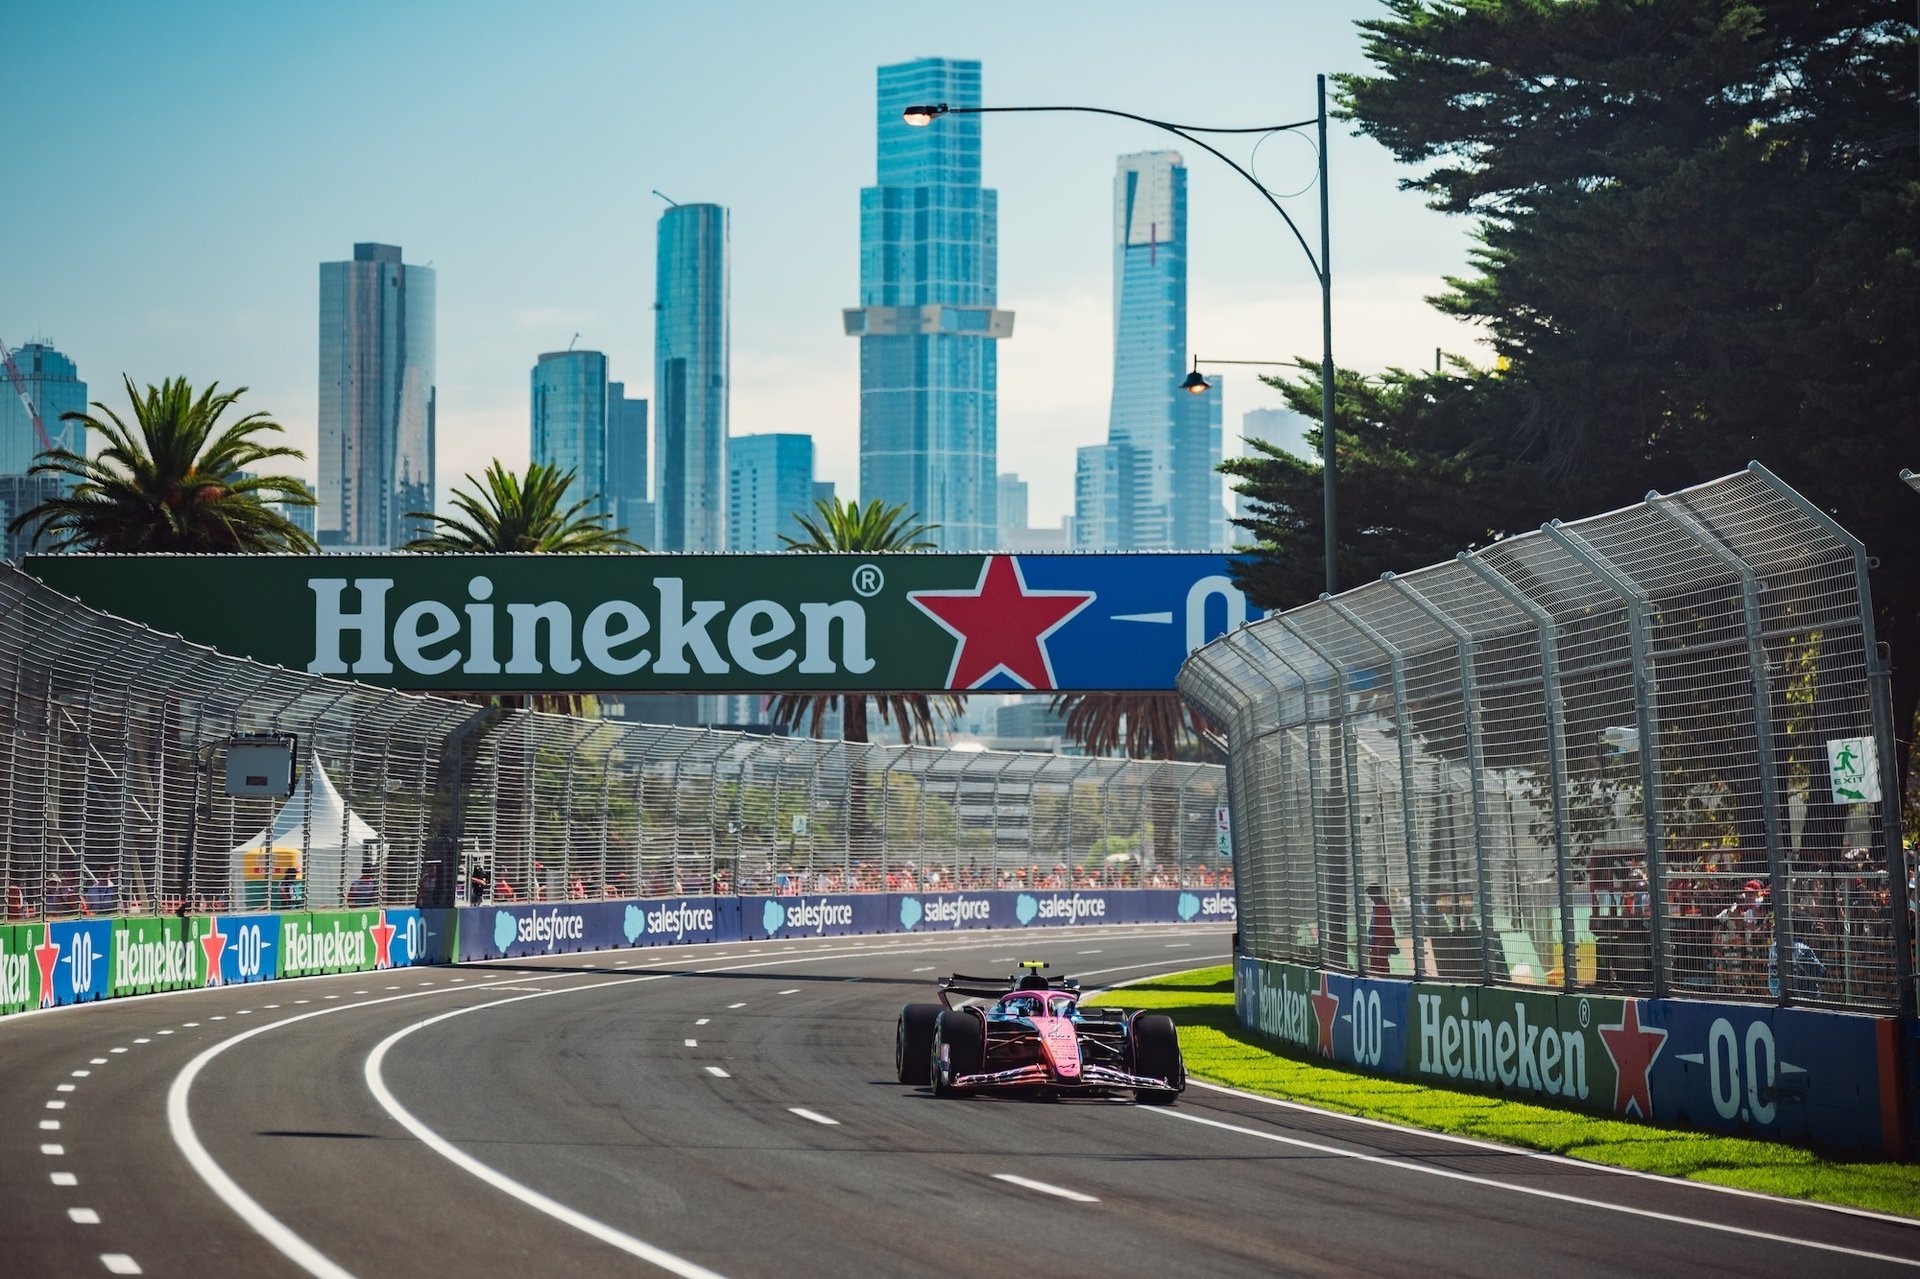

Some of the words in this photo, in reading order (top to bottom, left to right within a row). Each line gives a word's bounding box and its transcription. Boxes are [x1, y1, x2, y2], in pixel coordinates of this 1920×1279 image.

[307, 576, 876, 676] Heineken
[1833, 776, 1865, 786] EXIT
[647, 901, 713, 940] salesforce
[786, 898, 852, 933] salesforce
[924, 895, 990, 927] salesforce
[1038, 893, 1105, 924] salesforce
[518, 908, 583, 950] salesforce
[115, 928, 197, 987] Heineken
[238, 924, 261, 977] 0.0
[284, 920, 366, 971] Heineken
[1352, 988, 1382, 1066] 0.0
[1418, 994, 1589, 1100] Heineken
[1709, 1017, 1776, 1125] 0.0
